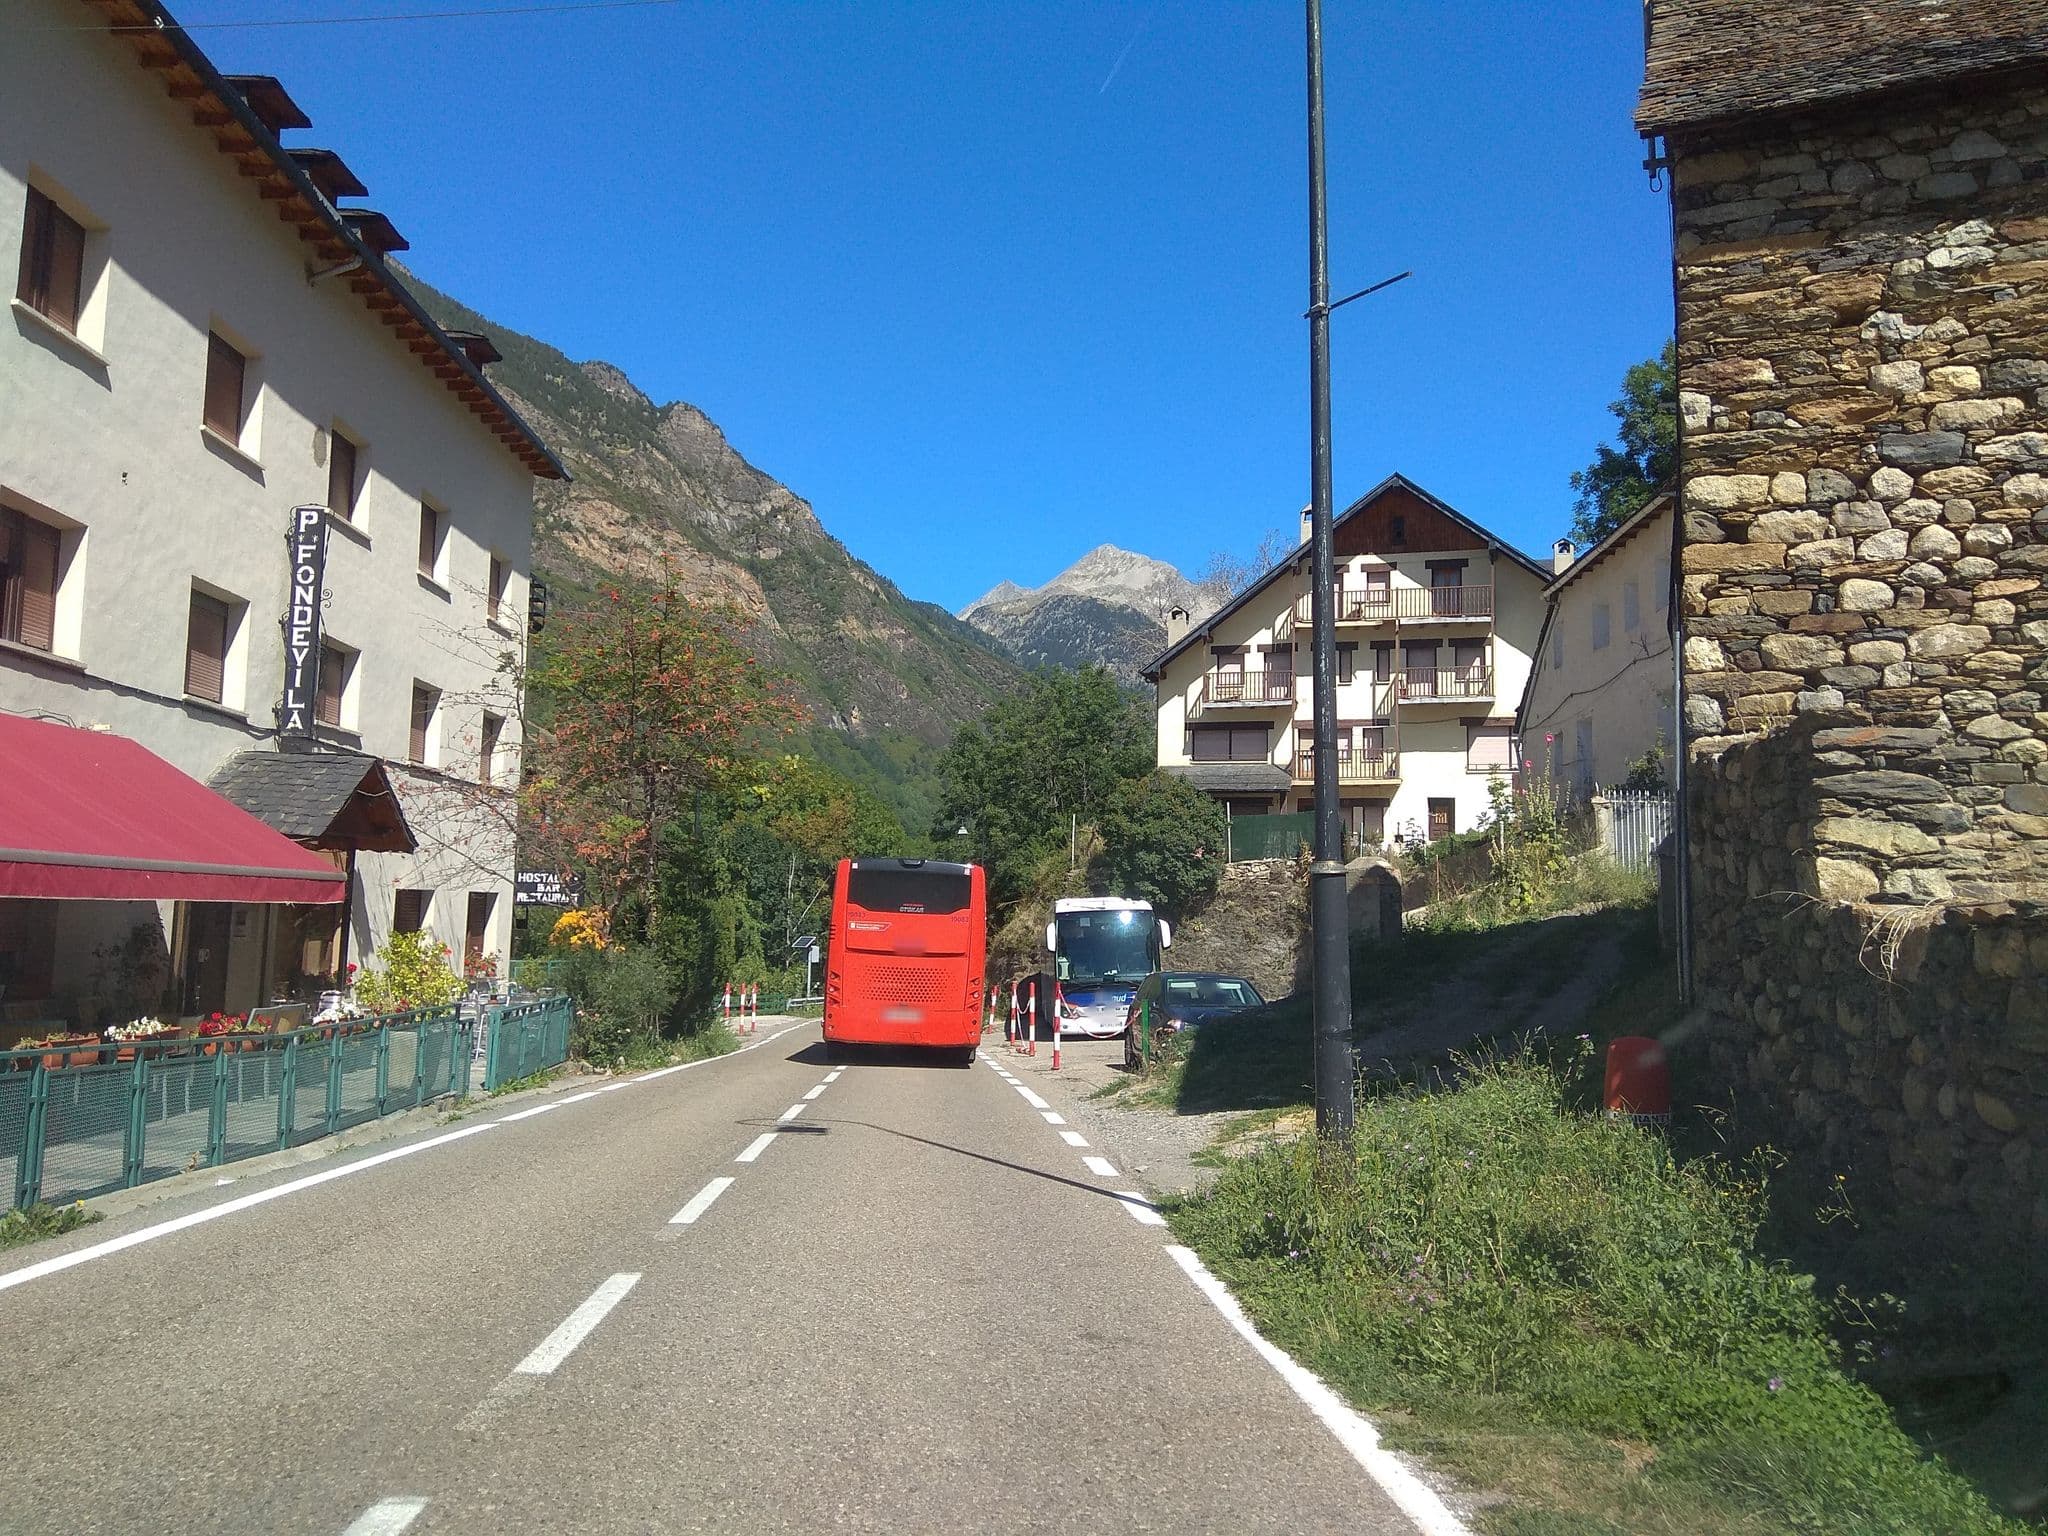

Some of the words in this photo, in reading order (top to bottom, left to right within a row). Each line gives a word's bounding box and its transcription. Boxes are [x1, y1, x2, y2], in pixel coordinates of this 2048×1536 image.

[299, 511, 318, 532] P
[517, 872, 560, 883] HOSTAL
[536, 883, 561, 892] BAR
[516, 892, 578, 903] RESTAURAT
